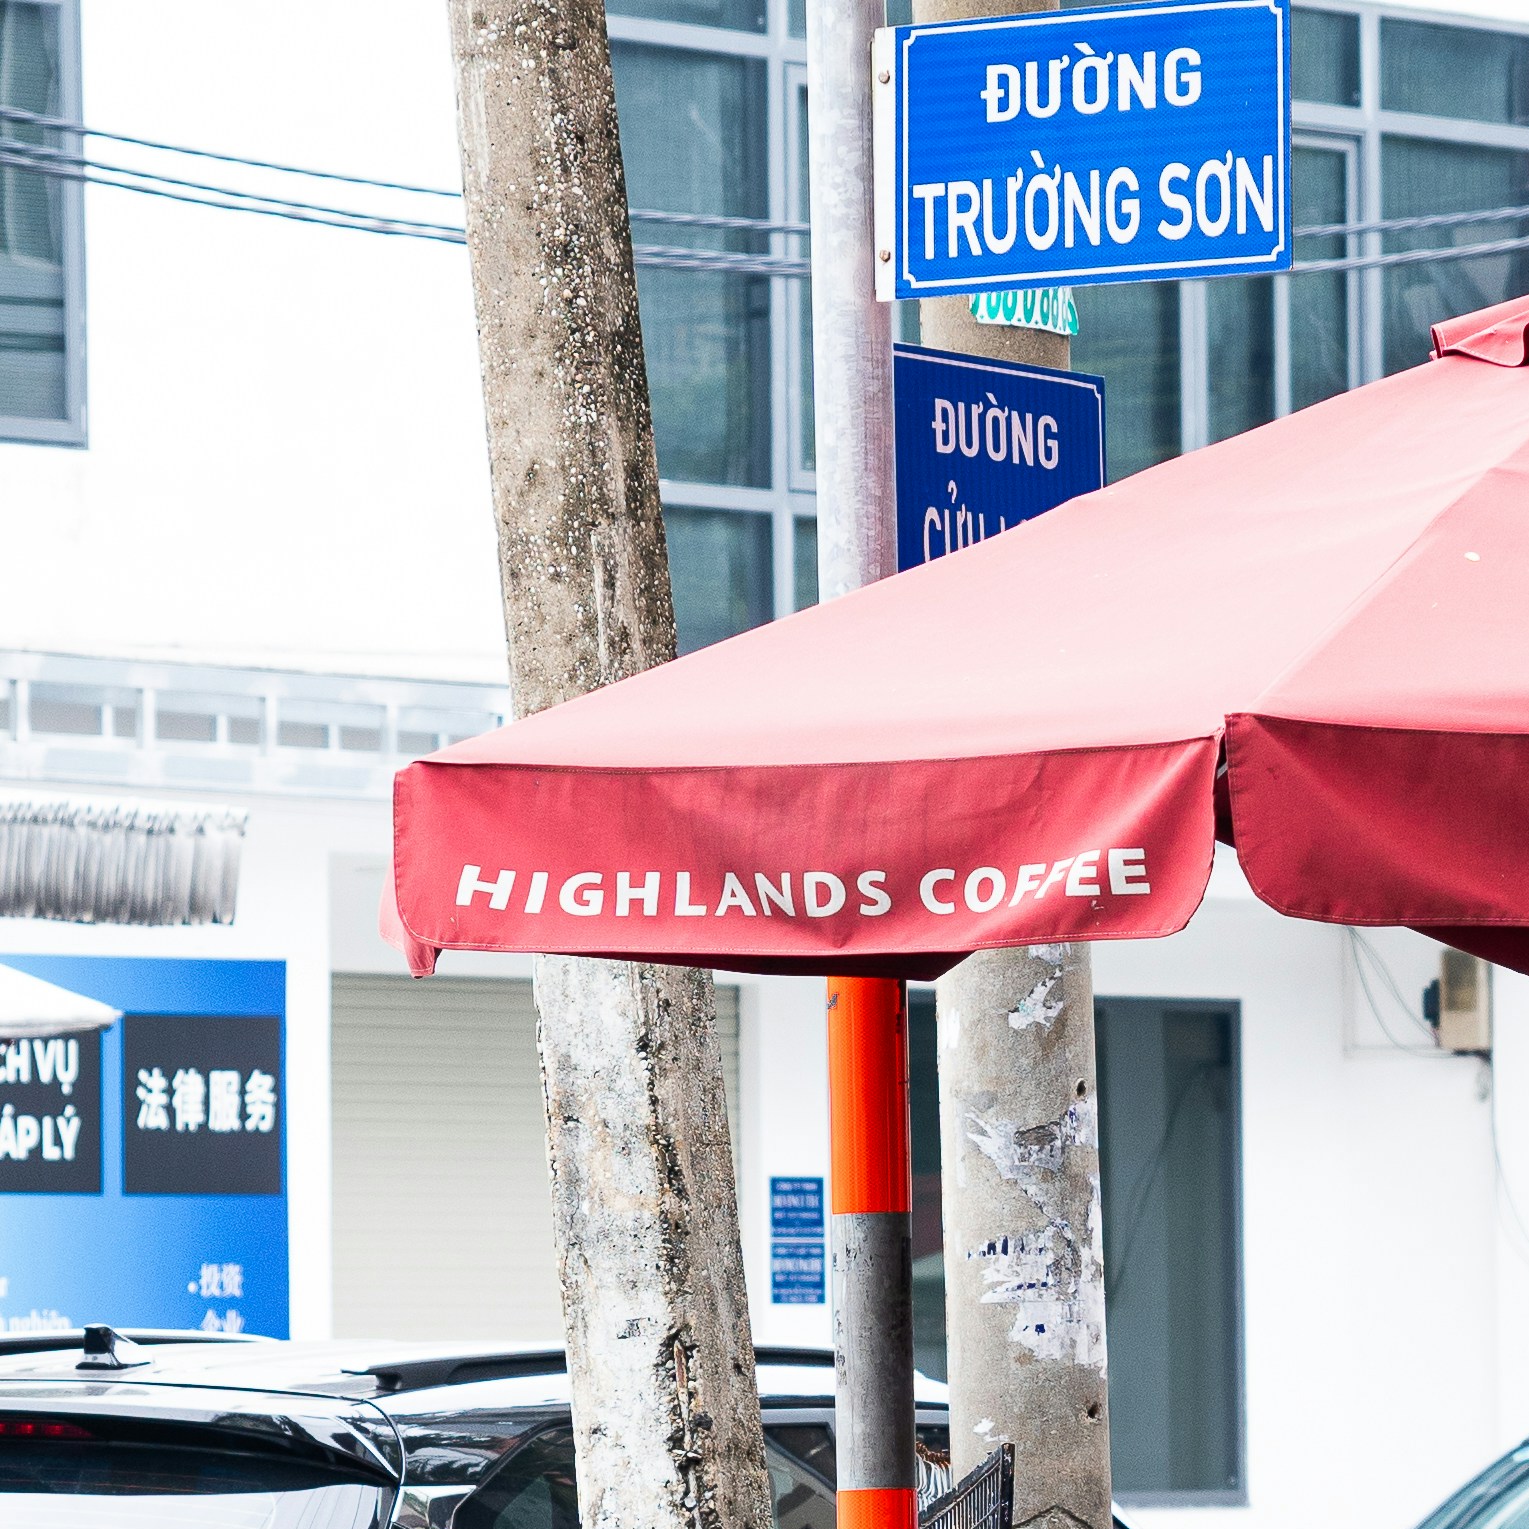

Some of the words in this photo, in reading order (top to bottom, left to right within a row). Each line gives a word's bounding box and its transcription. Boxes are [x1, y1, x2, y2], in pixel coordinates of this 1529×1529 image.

[979, 41, 1203, 124] ĐƯỜNG
[911, 150, 1141, 260] TRƯỜNG
[1157, 149, 1275, 241] SƠN
[931, 391, 1060, 470] ĐƯỜNG
[454, 863, 893, 918] HIGHLANDS
[918, 846, 1152, 914] COFFEE
[33, 1038, 80, 1096] VỤ
[135, 1066, 278, 1133] 法律服务
[41, 1103, 82, 1161] LÝ
